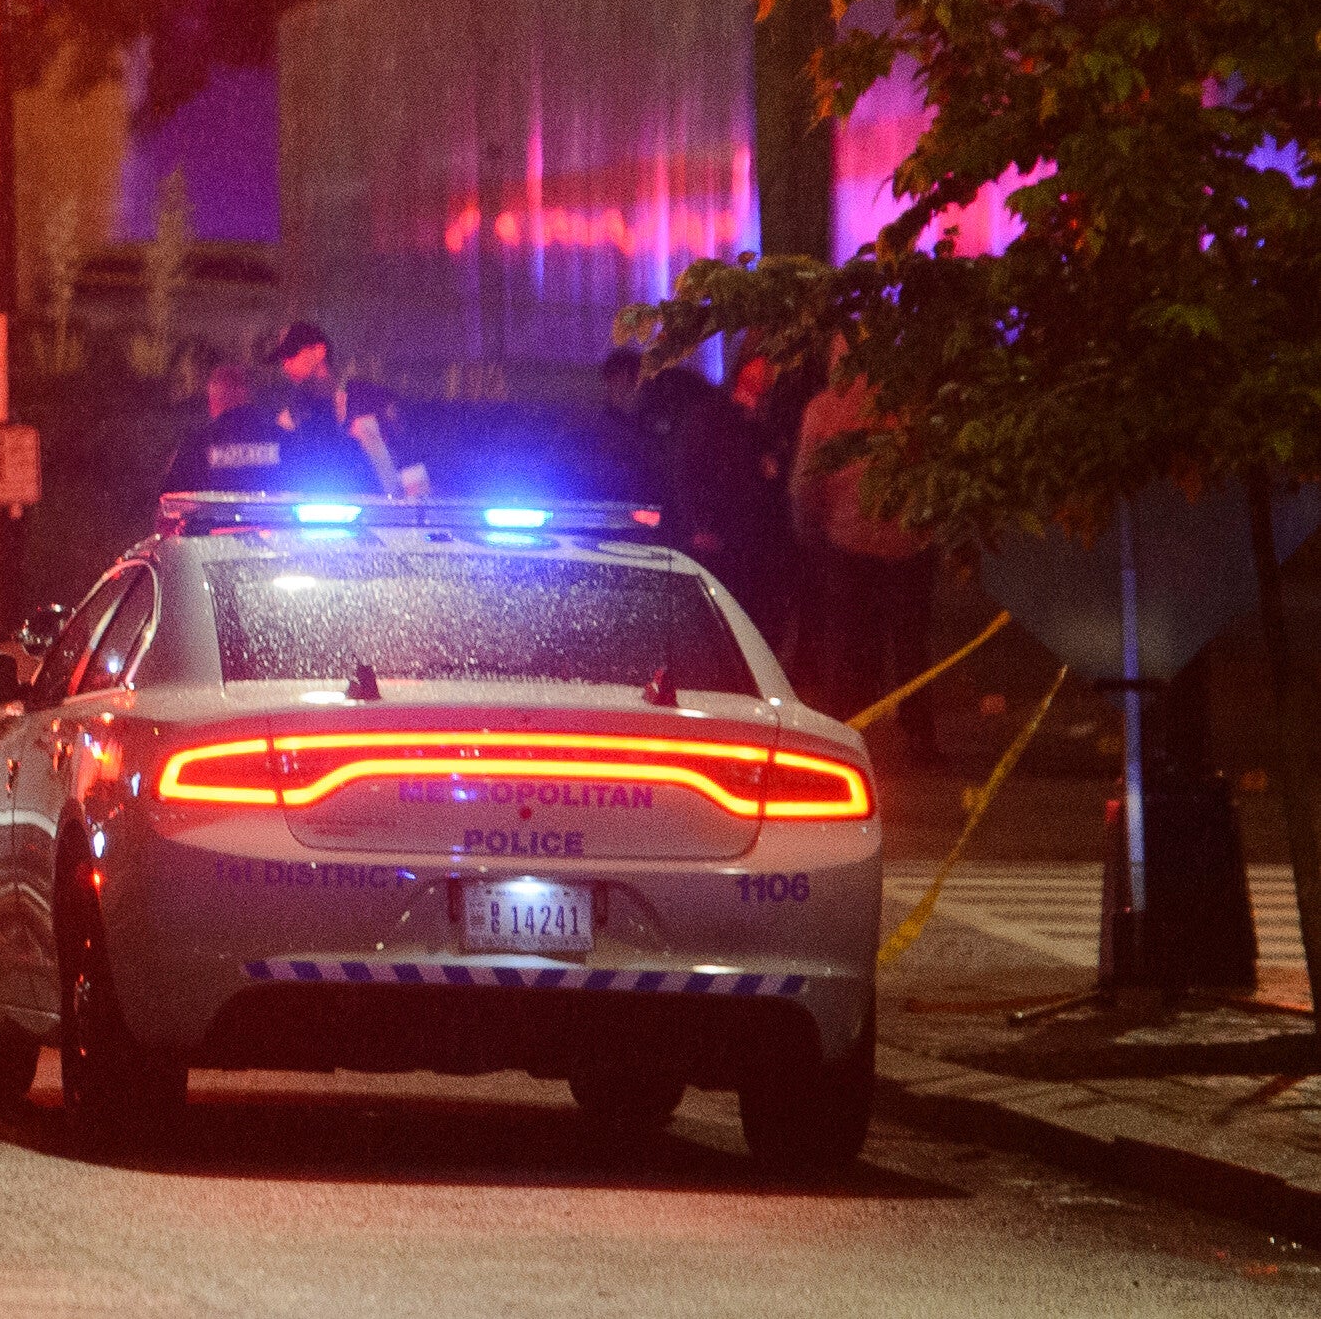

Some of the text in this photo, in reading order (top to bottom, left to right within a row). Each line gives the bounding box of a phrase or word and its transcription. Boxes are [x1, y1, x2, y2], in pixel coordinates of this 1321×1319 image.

[464, 829, 585, 856] POLICE
[736, 872, 810, 902] 1106
[511, 905, 579, 935] 14241
